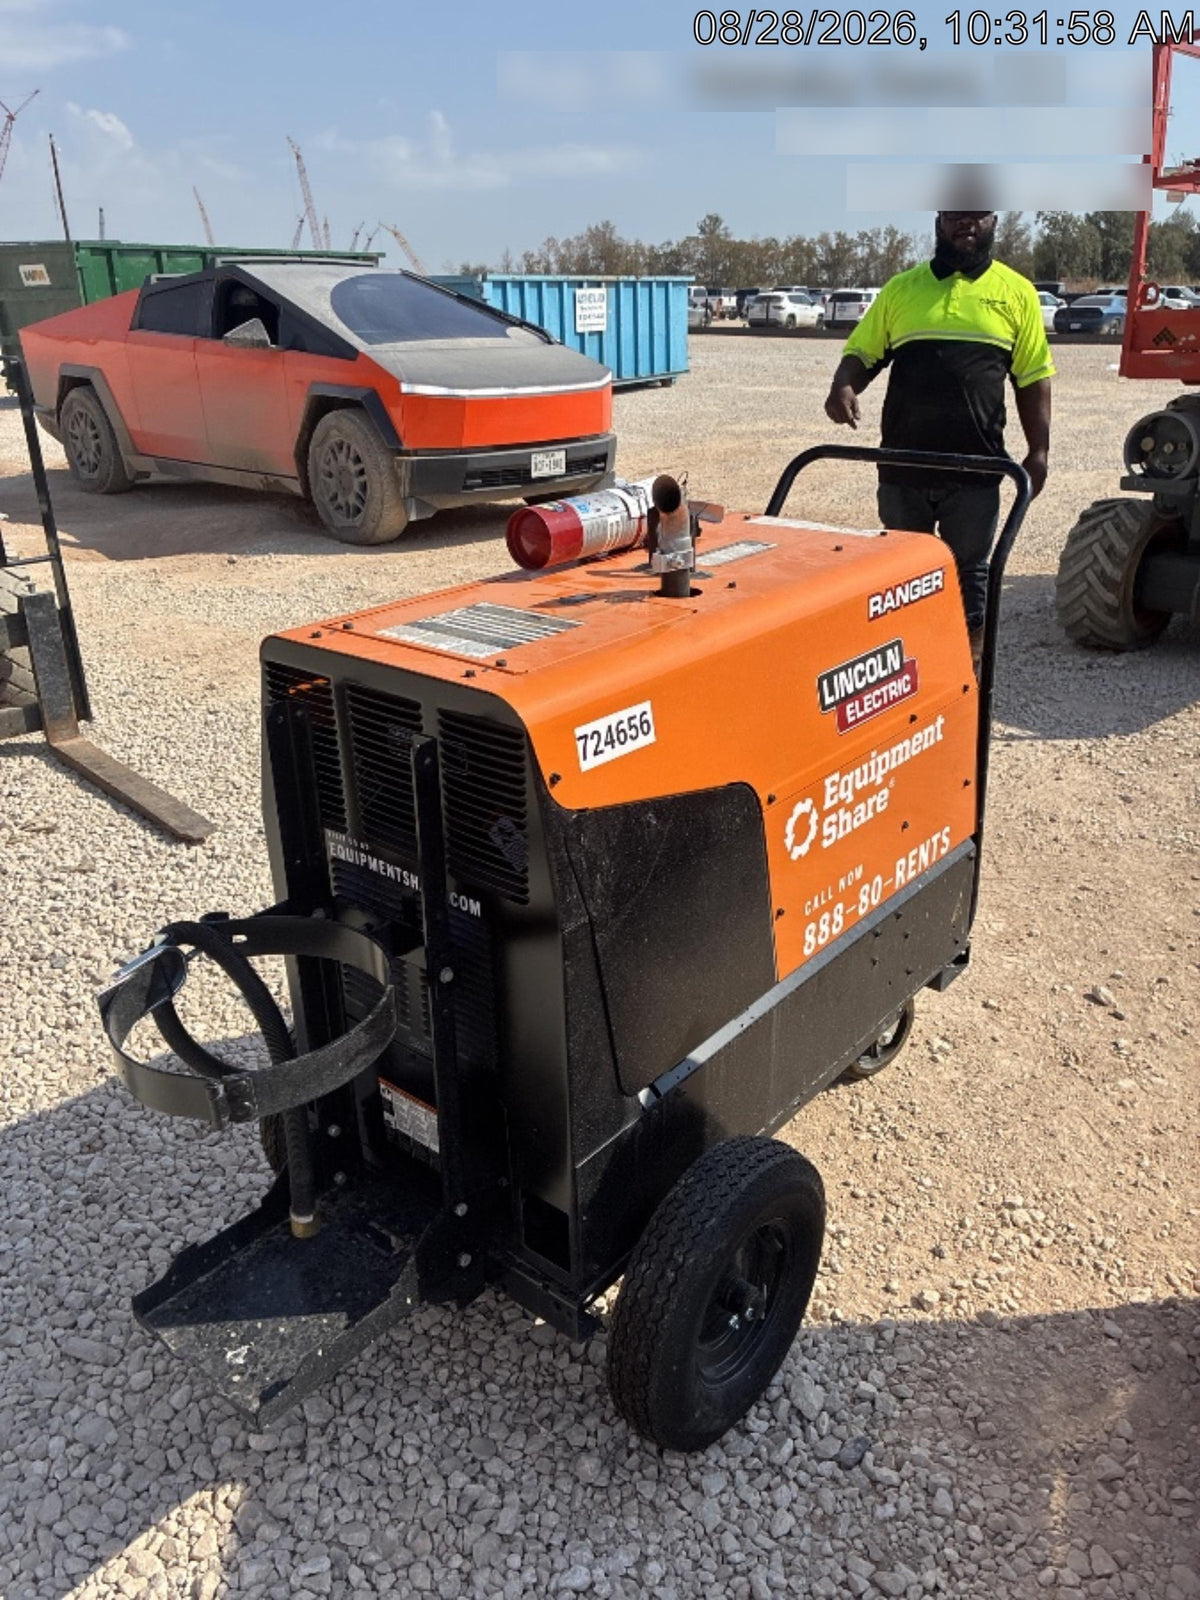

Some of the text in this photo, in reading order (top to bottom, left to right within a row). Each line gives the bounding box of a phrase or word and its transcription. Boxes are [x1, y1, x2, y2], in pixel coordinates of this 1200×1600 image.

[868, 569, 944, 621] RANGER
[821, 644, 902, 706] LINCOLN
[845, 673, 912, 725] ELECTRIC
[576, 710, 651, 762] 724656
[822, 713, 945, 811] Equipment
[802, 825, 951, 956] 888-80-RENTS
[804, 863, 864, 916] CALL NOW
